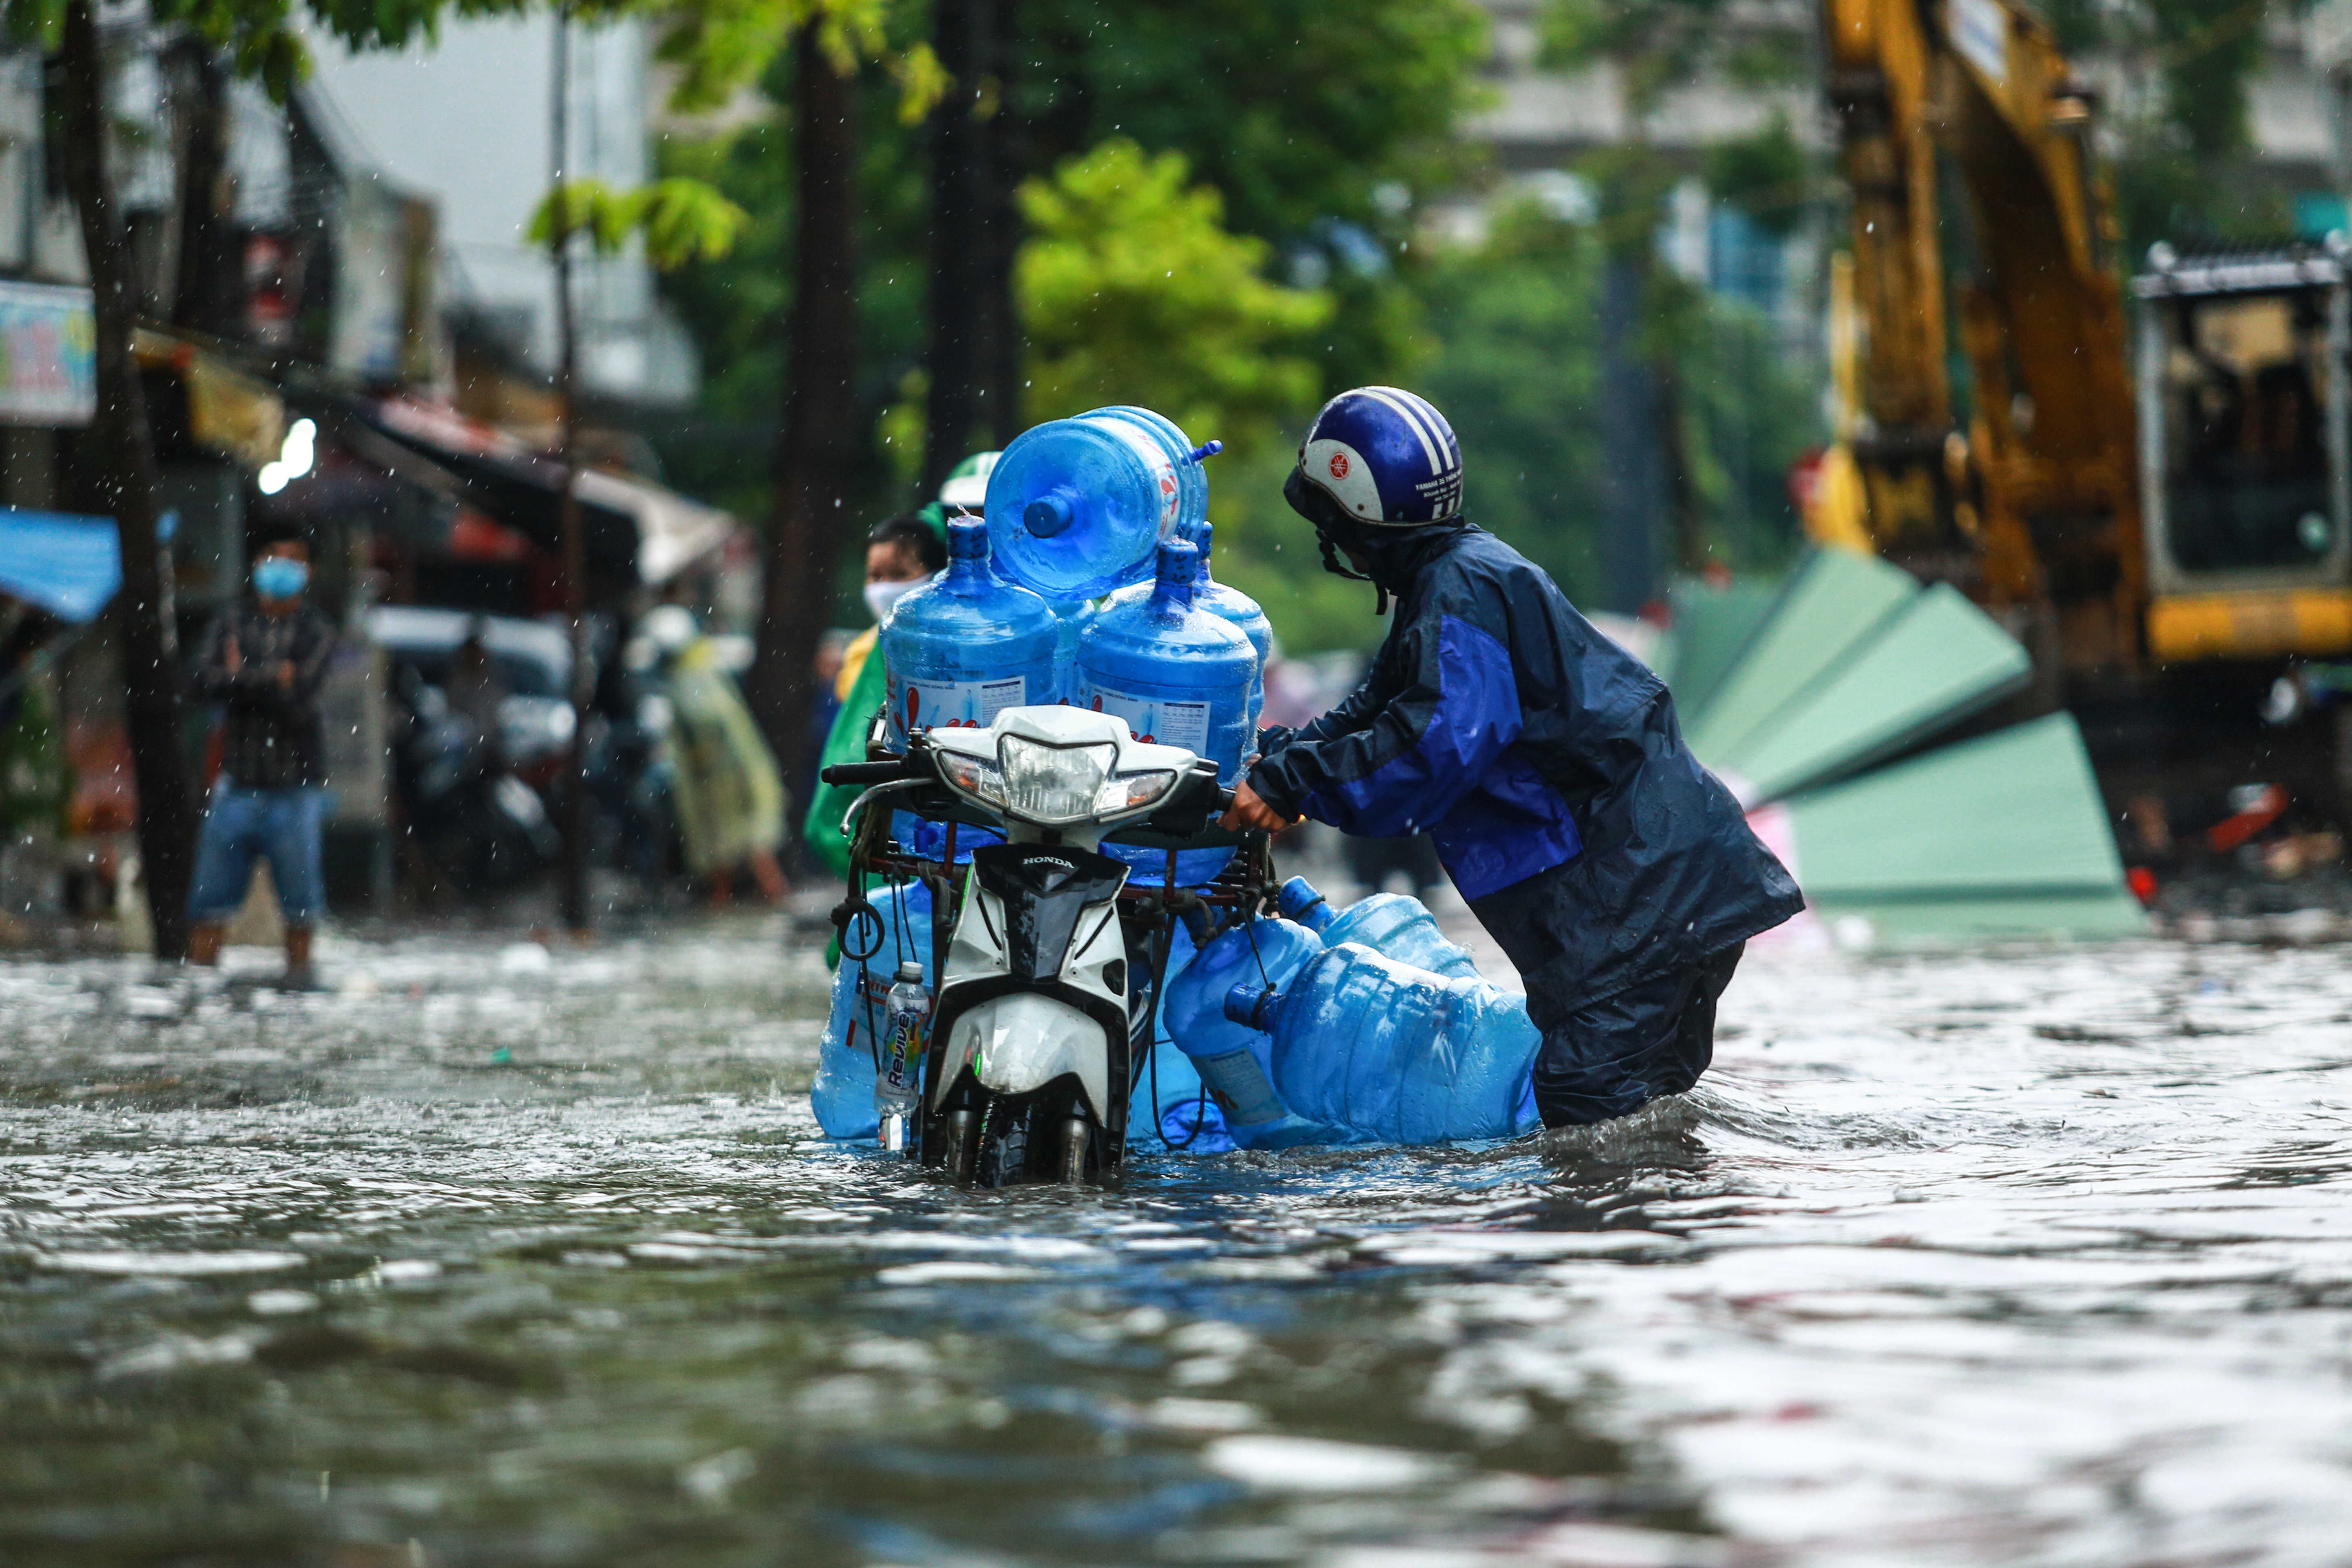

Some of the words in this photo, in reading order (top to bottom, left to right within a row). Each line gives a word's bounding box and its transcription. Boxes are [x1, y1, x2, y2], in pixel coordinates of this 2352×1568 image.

[1415, 480, 1439, 490] YAMAHA
[1023, 856, 1075, 869] HONDA
[888, 1012, 910, 1088] Revive
